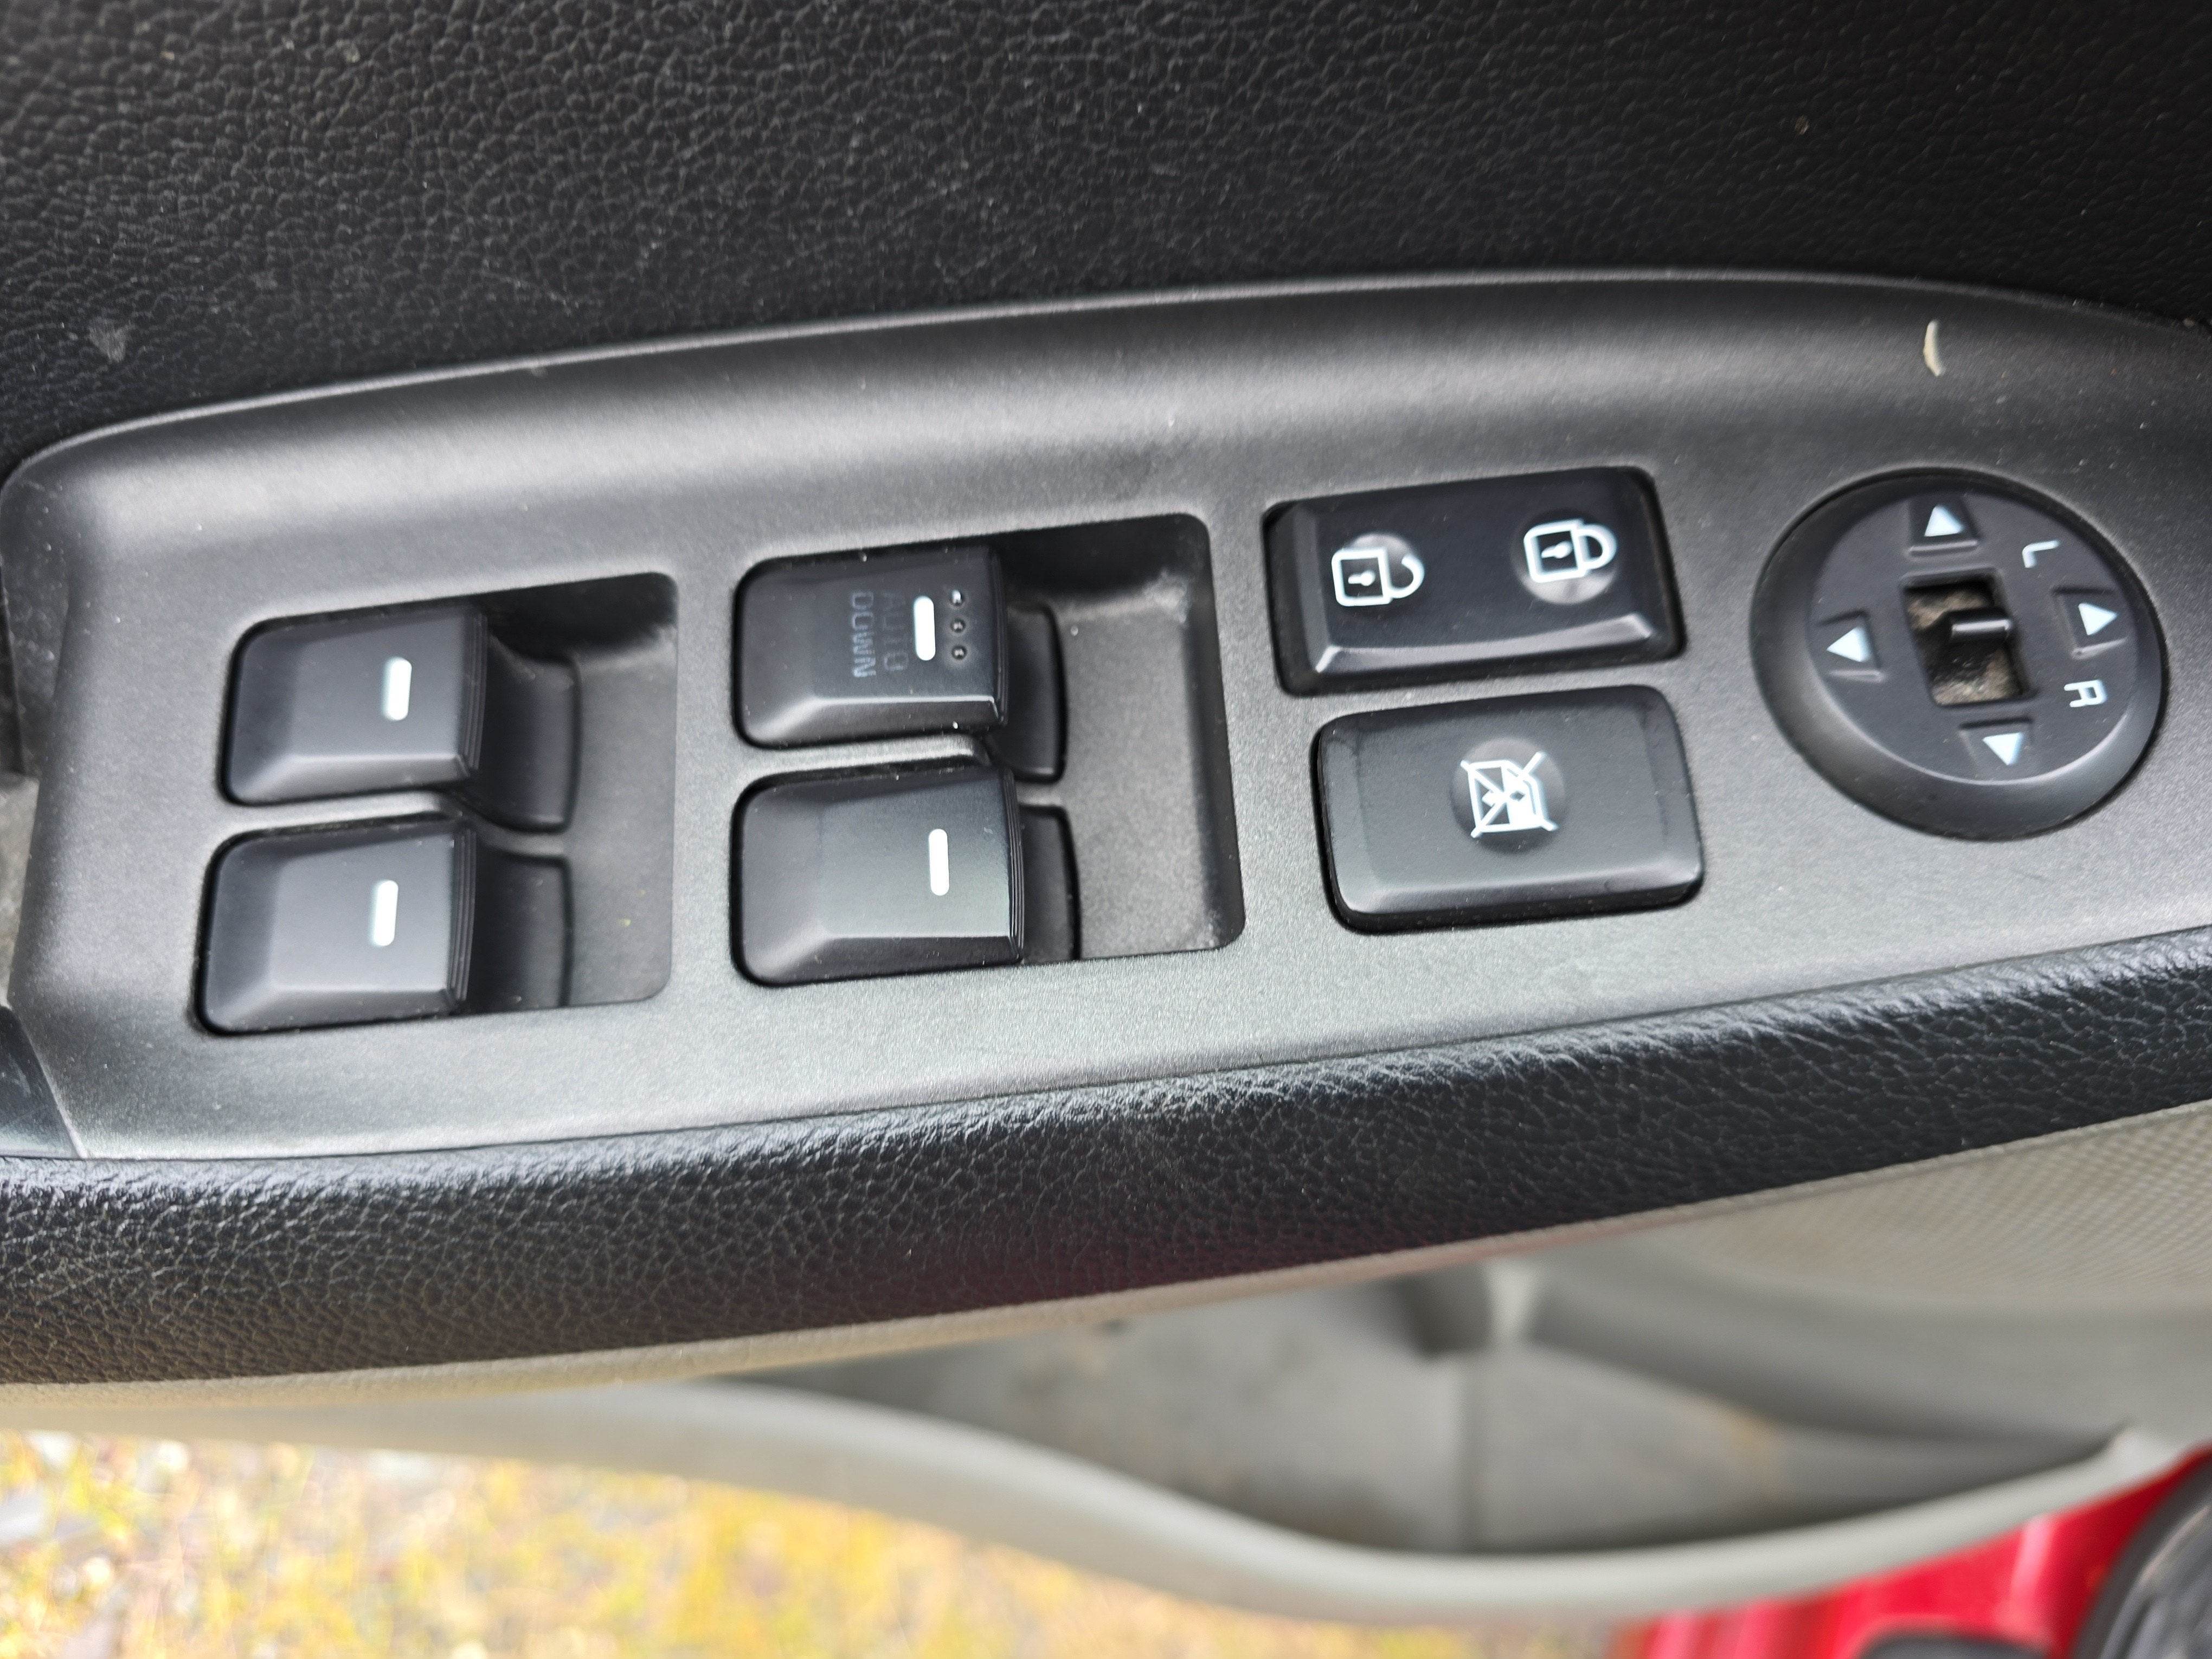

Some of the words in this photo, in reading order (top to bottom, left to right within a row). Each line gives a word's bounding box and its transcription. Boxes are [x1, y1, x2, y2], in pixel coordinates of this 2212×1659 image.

[2022, 541, 2059, 568] L
[852, 591, 876, 677] DOWN
[2064, 679, 2107, 708] R
